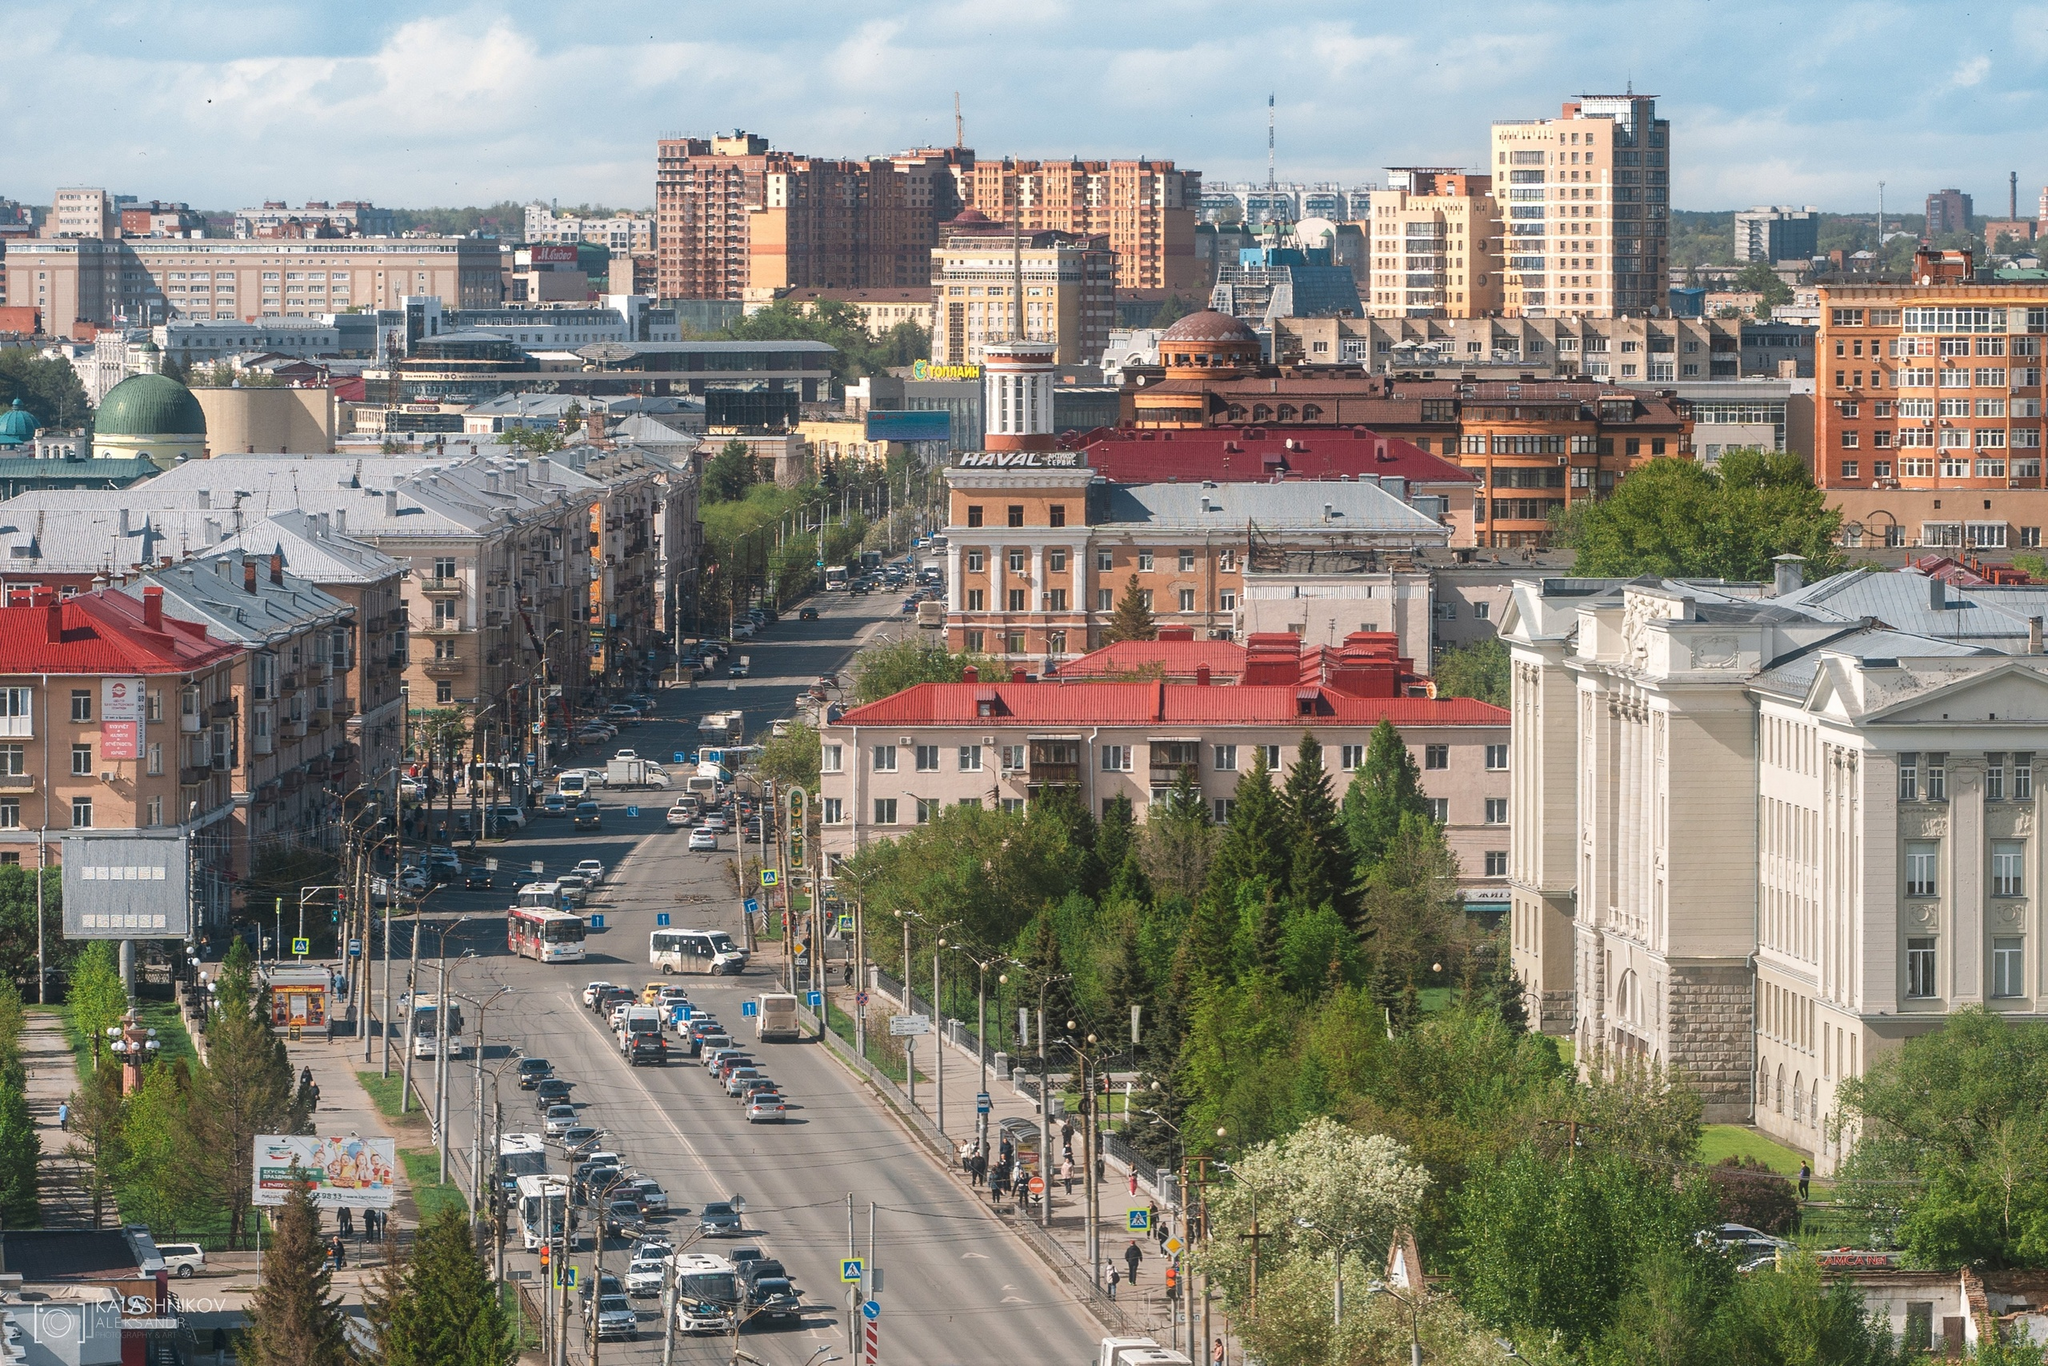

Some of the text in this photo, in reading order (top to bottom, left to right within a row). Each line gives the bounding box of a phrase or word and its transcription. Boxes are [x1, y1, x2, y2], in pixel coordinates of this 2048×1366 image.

[929, 362, 980, 378] ТОПЛАЙН
[960, 453, 1042, 466] HAVAL
[1816, 1254, 1887, 1265] САМСА №1
